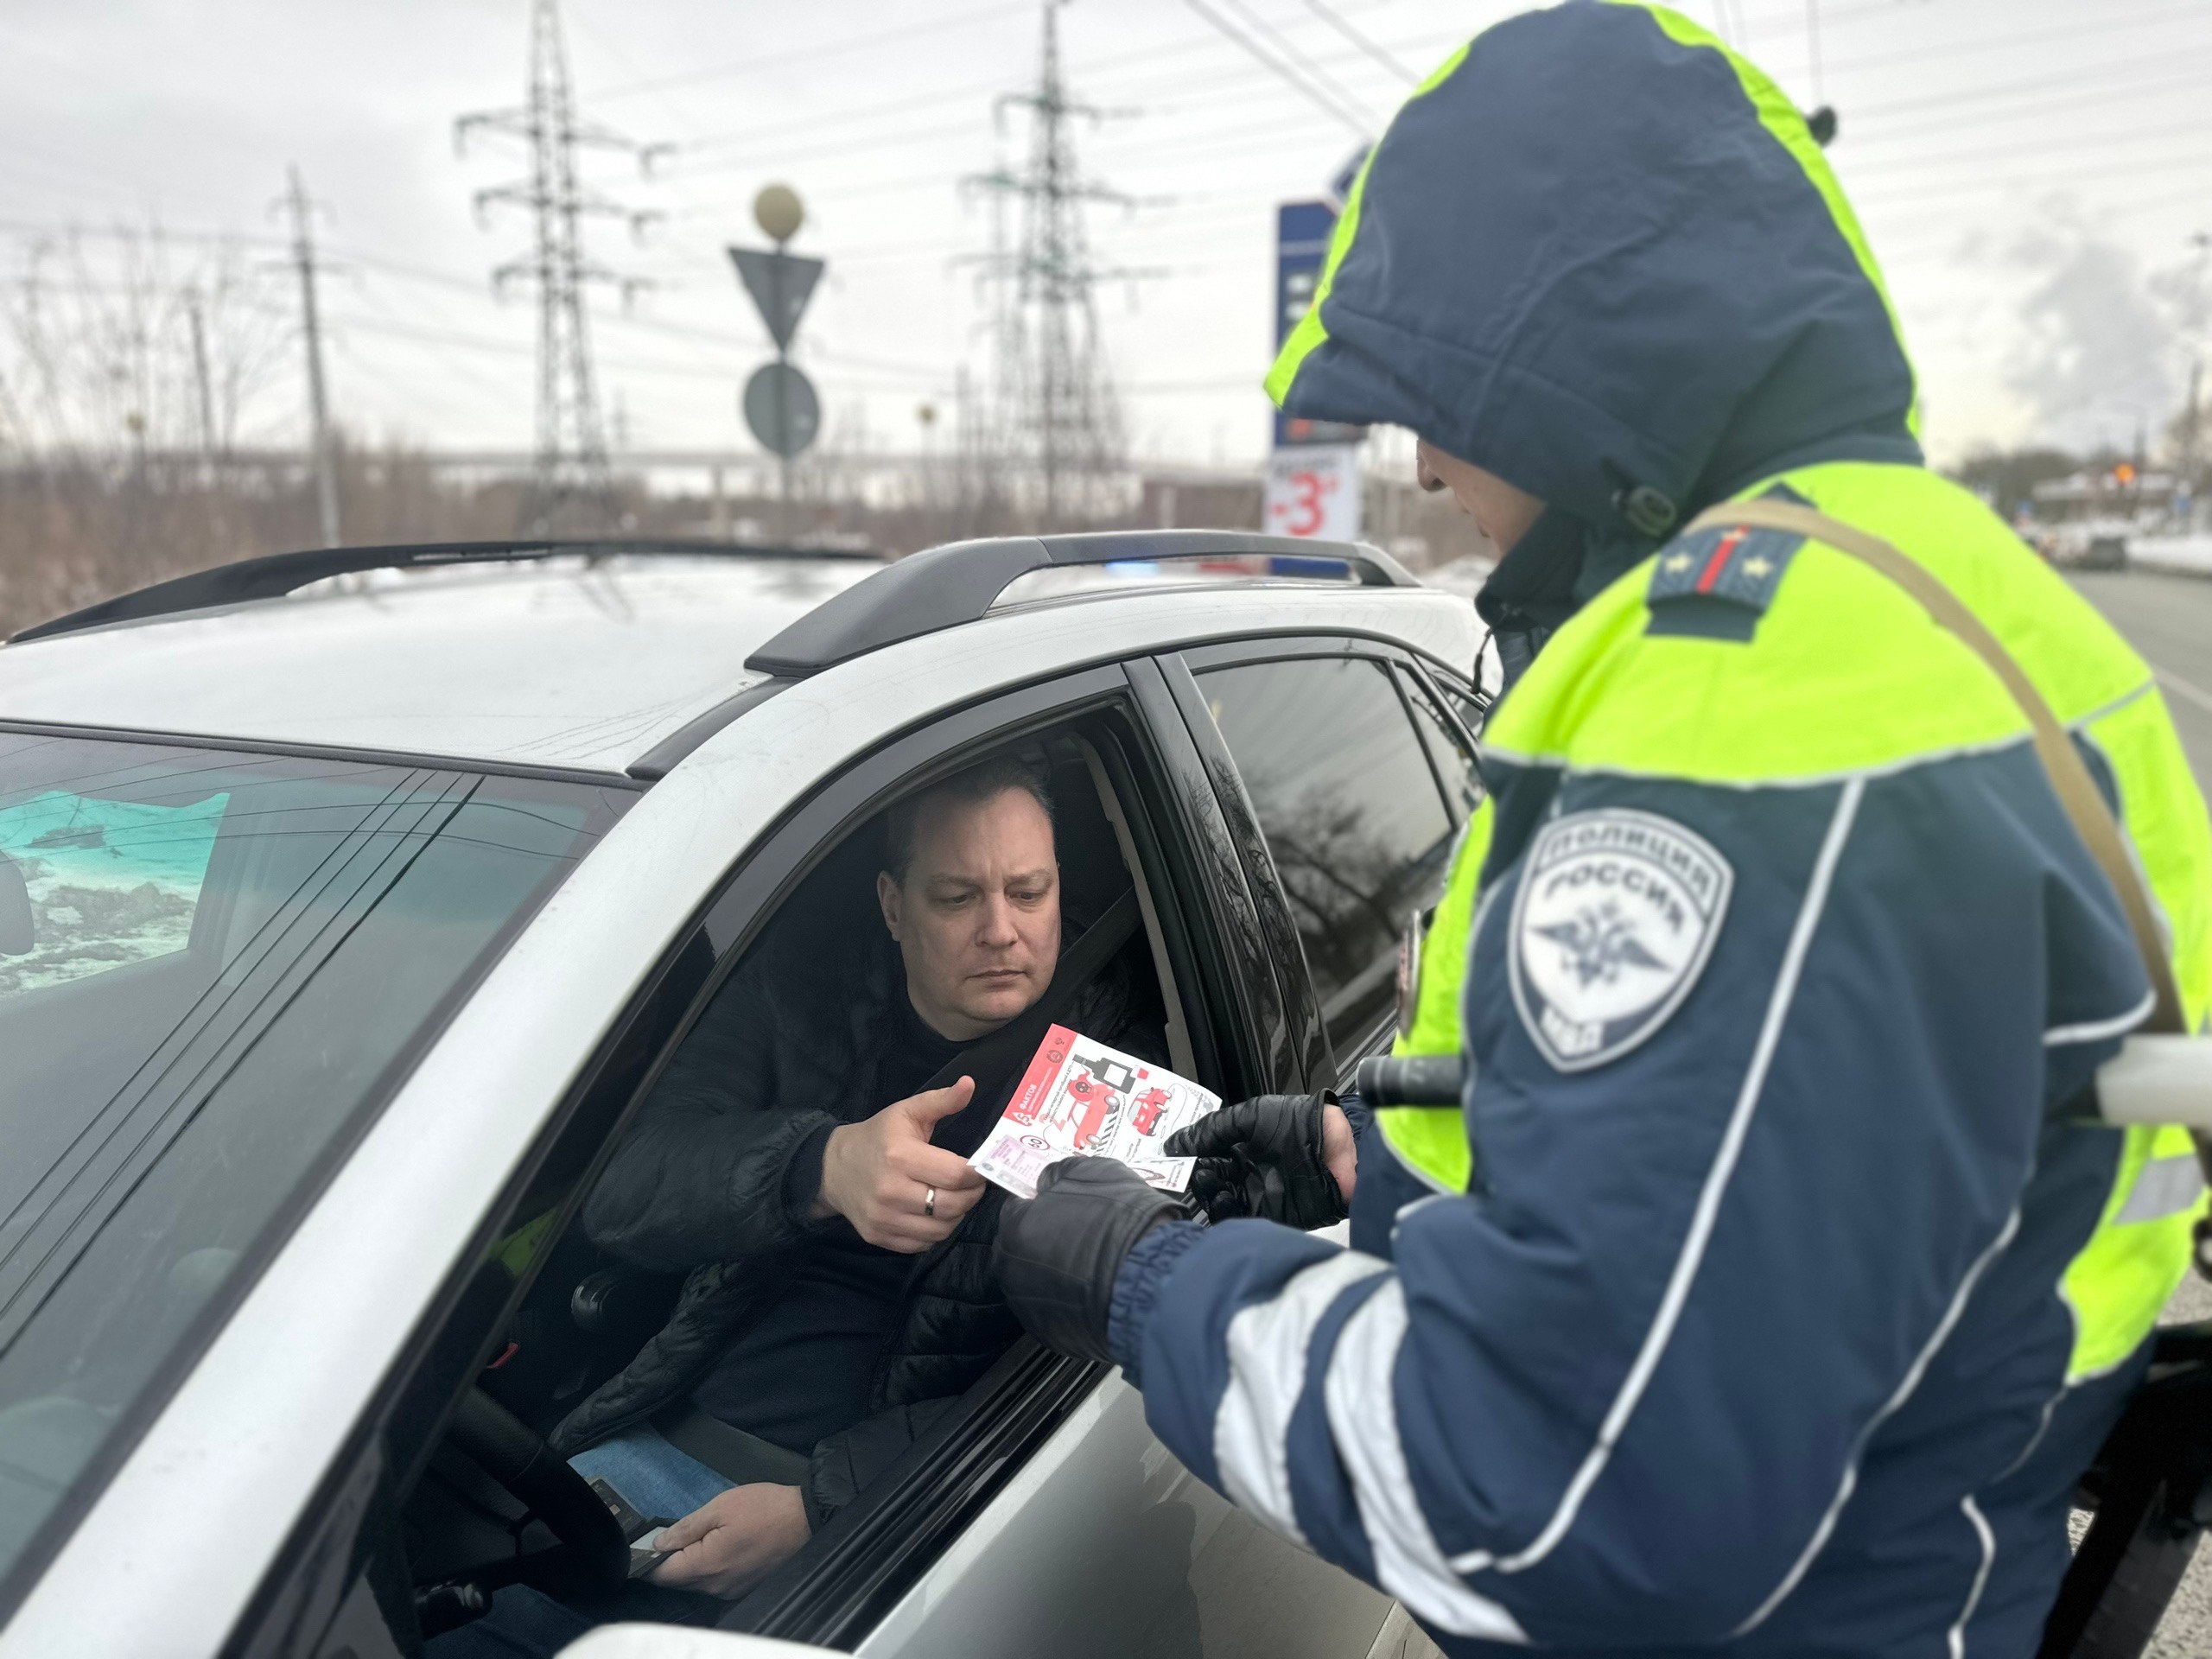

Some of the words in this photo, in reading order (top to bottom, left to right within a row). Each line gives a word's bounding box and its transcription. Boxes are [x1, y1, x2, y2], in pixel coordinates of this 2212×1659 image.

[1549, 826, 1710, 895] ПОЛИЦИЯ
[1020, 1084, 1038, 1110] ФАКТОВ
[1027, 1137, 1042, 1148] 60
